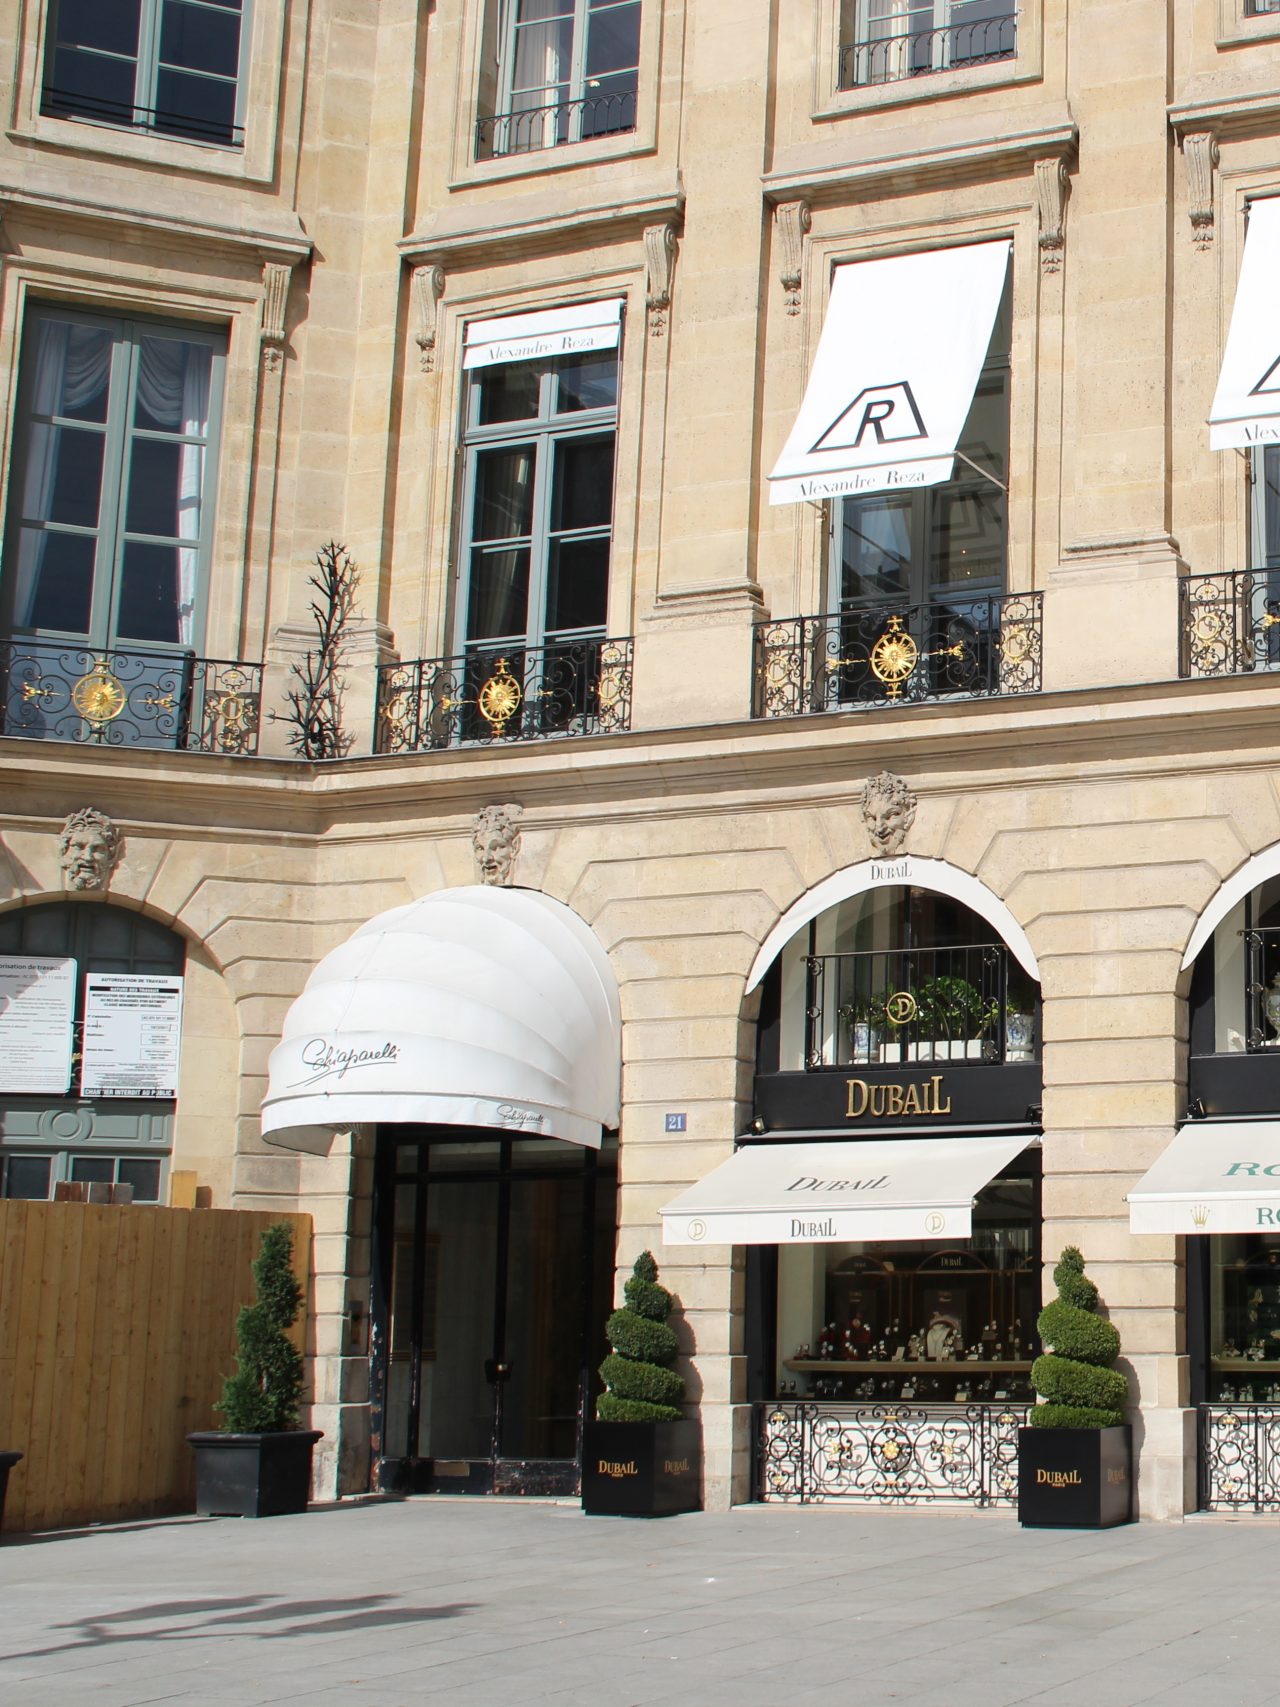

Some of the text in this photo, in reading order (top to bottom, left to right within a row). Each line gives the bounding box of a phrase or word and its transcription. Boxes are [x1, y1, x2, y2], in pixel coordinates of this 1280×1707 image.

[488, 336, 594, 361] Alexandre Reza
[800, 470, 925, 497] Alexandre Reza
[870, 861, 913, 881] DUBAIL
[845, 1075, 952, 1119] DUBAIL
[668, 1116, 683, 1129] 21
[783, 1175, 893, 1192] DUBAIL
[790, 1217, 837, 1238] DUBAIL
[599, 1459, 638, 1475] DUBAIL
[1037, 1469, 1082, 1484] DUBAIL
